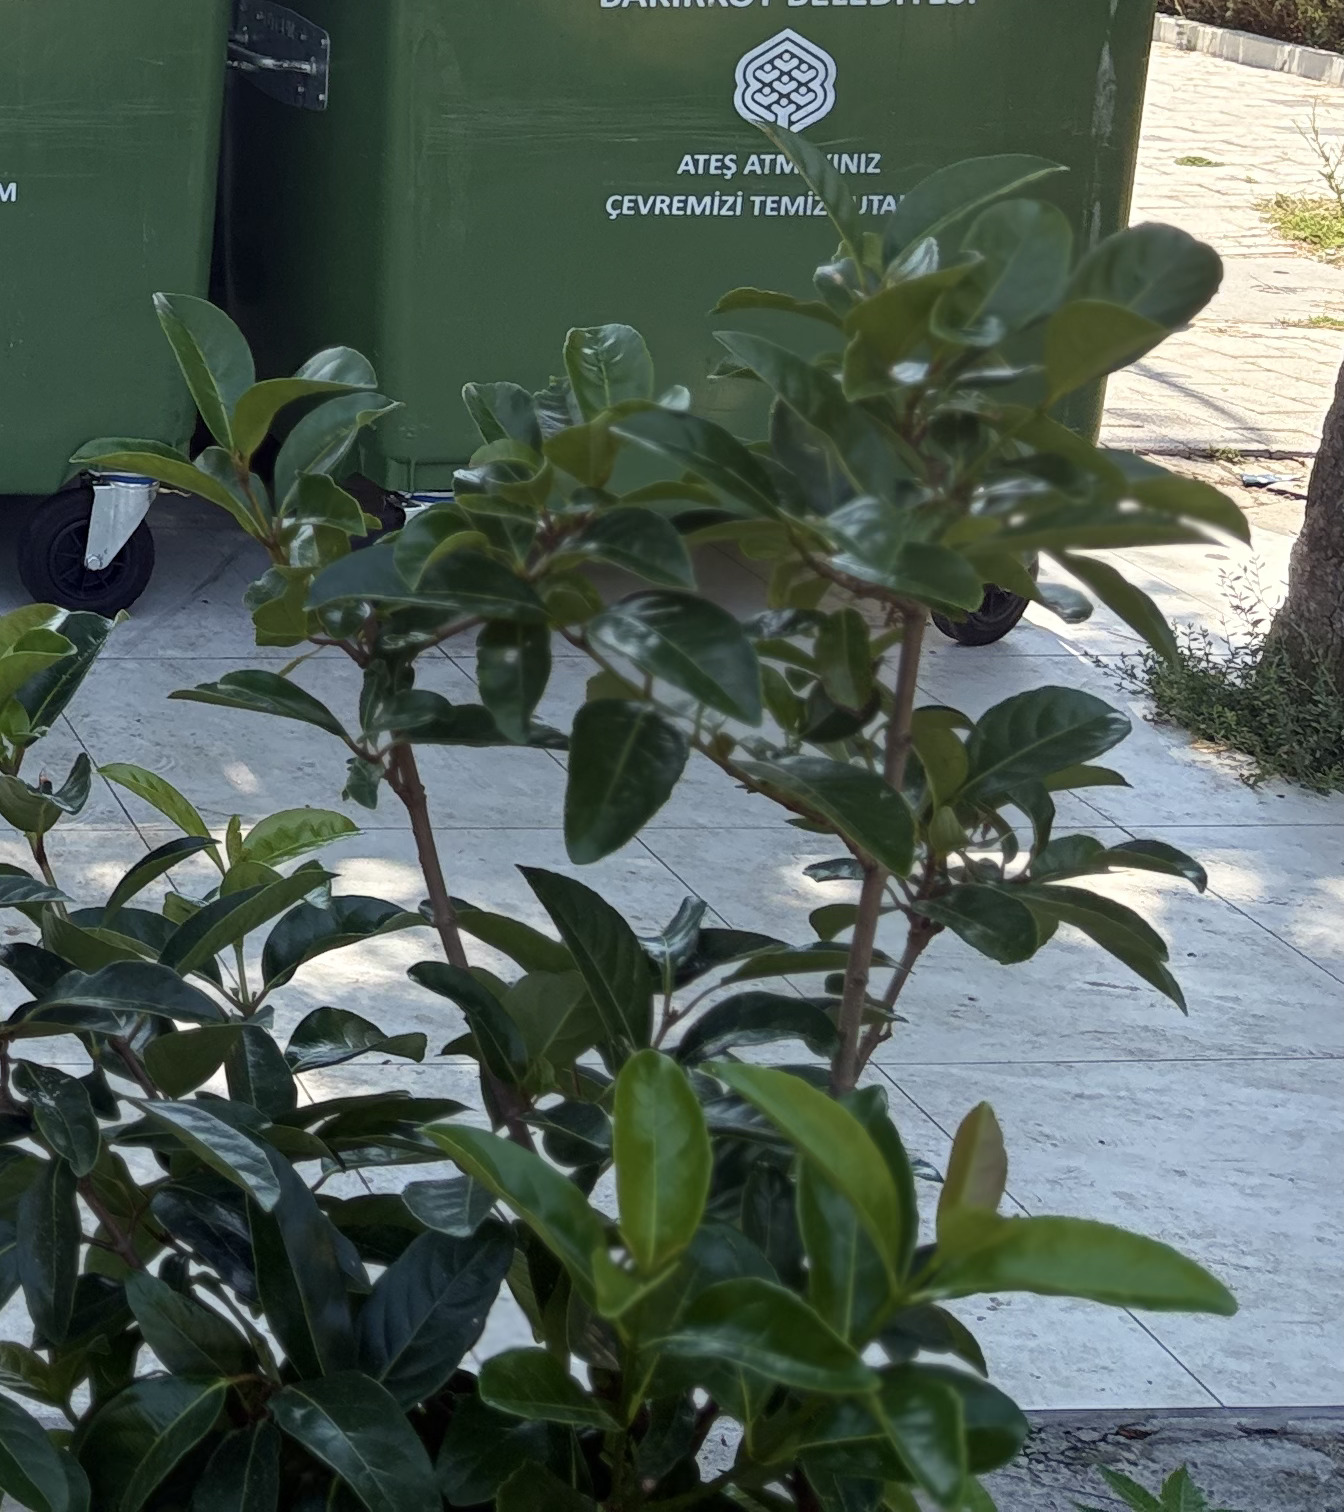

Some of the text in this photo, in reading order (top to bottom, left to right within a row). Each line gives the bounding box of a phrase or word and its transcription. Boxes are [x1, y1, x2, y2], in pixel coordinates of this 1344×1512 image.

[676, 153, 882, 180] ATEŞ ATMINIZ
[605, 190, 743, 220] ÇEVREMİZİ
[749, 190, 828, 216] TEMİZ
